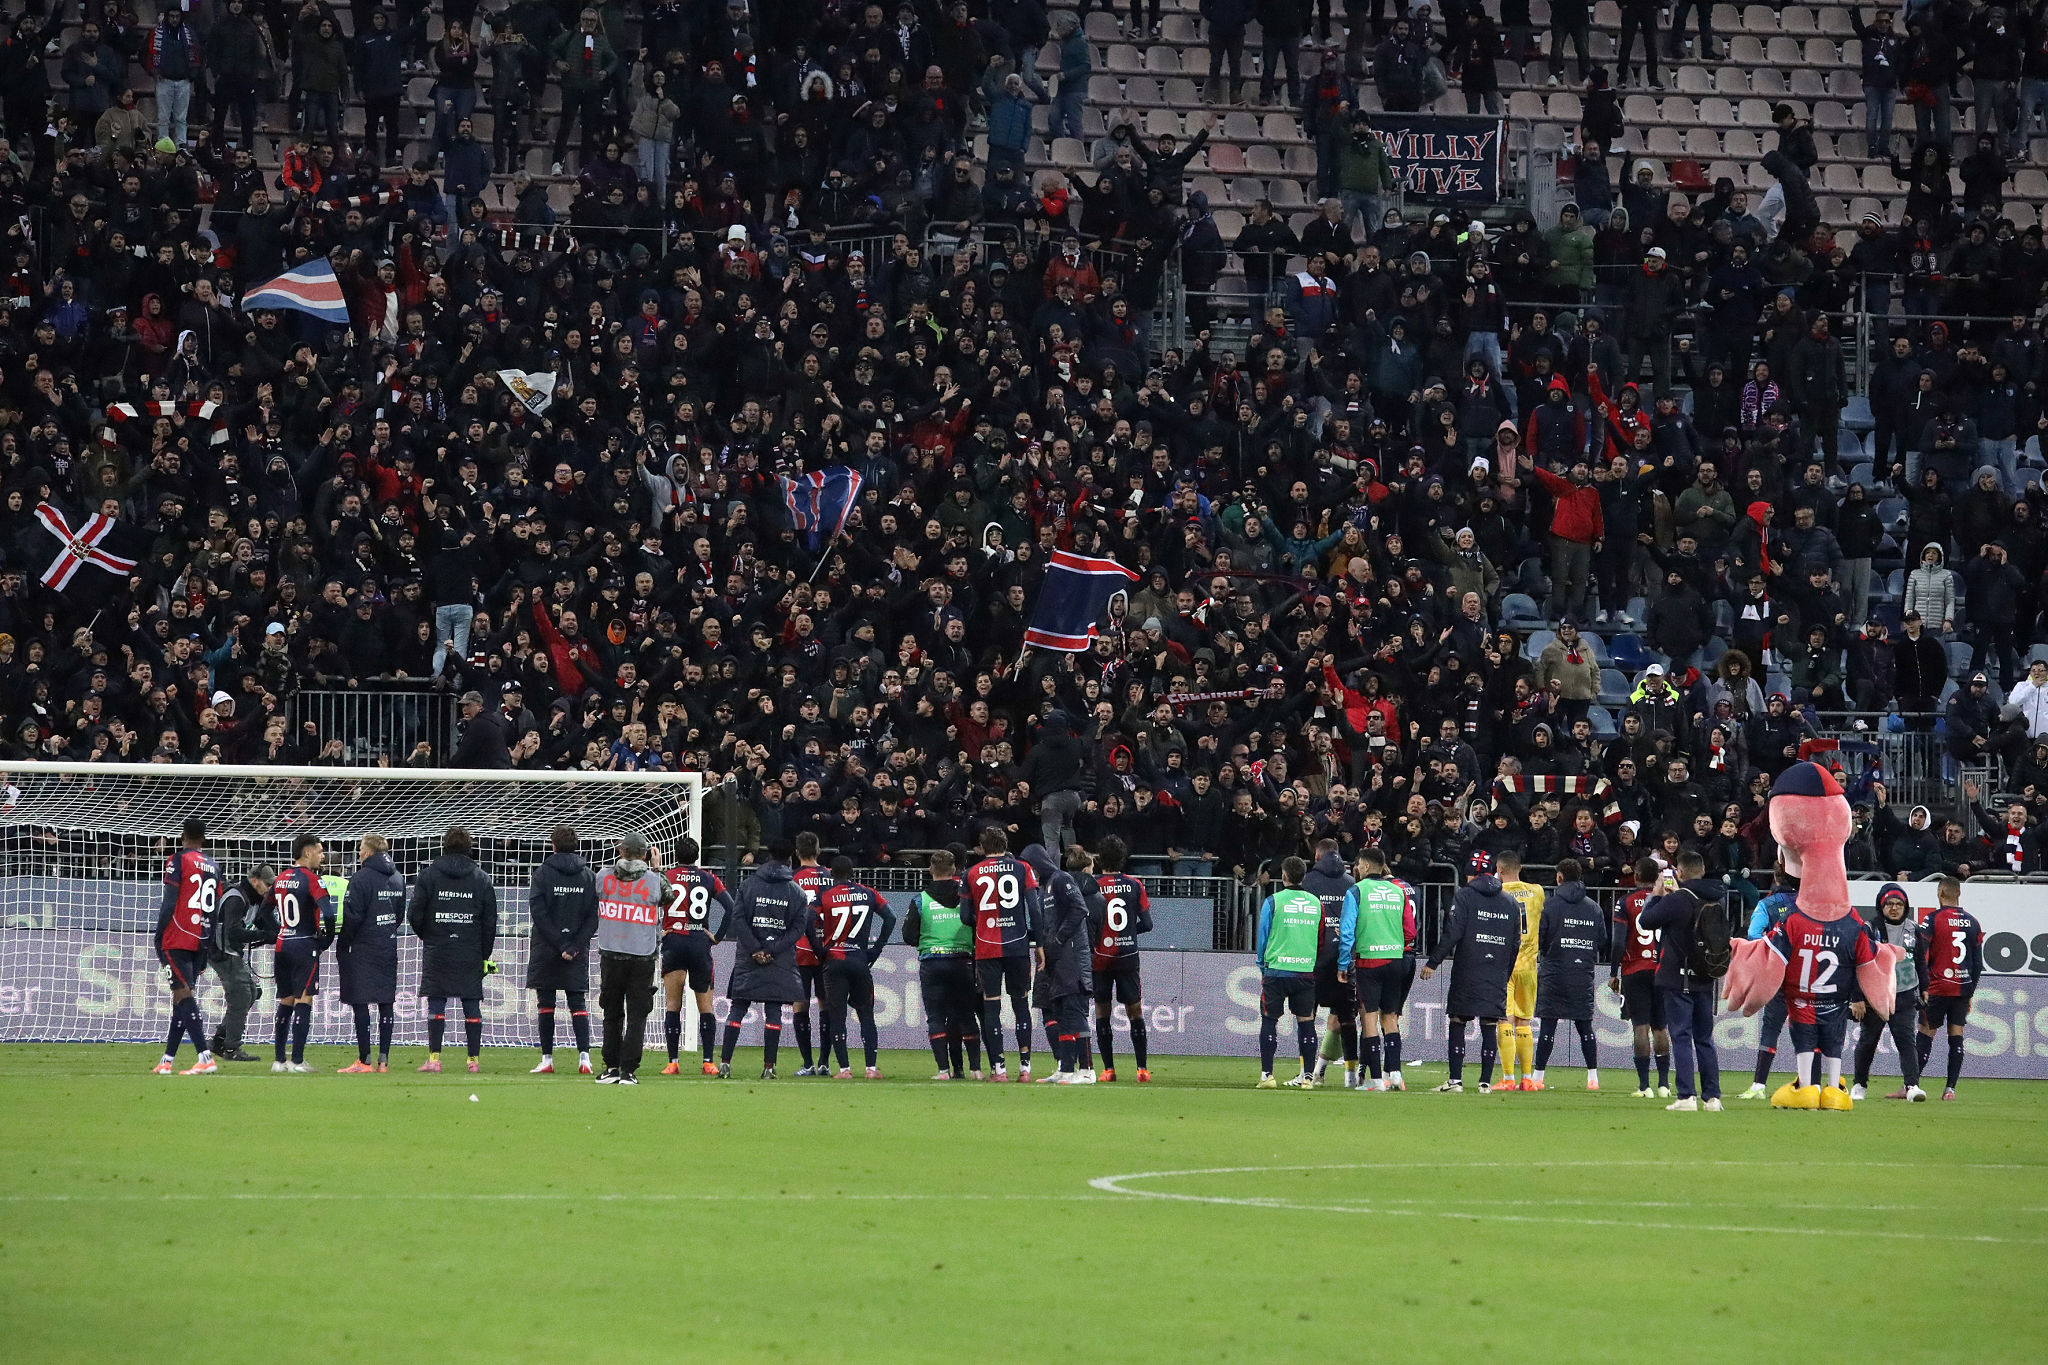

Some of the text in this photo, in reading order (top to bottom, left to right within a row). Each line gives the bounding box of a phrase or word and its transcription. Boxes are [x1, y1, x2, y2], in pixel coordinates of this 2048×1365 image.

[1372, 128, 1496, 161] WILLY
[1388, 162, 1483, 195] VIVE
[978, 863, 1014, 875] BORRELLI
[676, 873, 701, 883] ZAPPA
[187, 873, 217, 913] 26
[552, 886, 585, 894] MERIDIAN
[603, 874, 650, 901] 094
[975, 874, 1020, 911] 29
[1100, 884, 1132, 895] LUPERTO
[438, 890, 473, 899] MERIDIAN
[832, 892, 868, 903] LUVUMBO
[667, 883, 709, 920] 28
[755, 896, 789, 907] MERIDIAN
[1369, 903, 1401, 911] MERIDIAN
[274, 893, 301, 928] 10
[435, 911, 474, 920] EYESPORT
[1107, 897, 1128, 932] 6
[1477, 909, 1510, 921] MERIDIAN
[831, 905, 870, 941] 77
[1283, 918, 1315, 926] MERIDIAN
[1564, 918, 1595, 927] MERIDIAN
[1947, 918, 1971, 928] IDRISSI
[1476, 933, 1506, 943] EYESPORT
[1560, 937, 1594, 947] EYESPORT
[1804, 934, 1840, 948] PULLY
[1369, 944, 1402, 952] EYESPORT
[1951, 931, 1967, 965] 3
[1277, 955, 1313, 964] EYESPORT
[1798, 948, 1840, 994] 12
